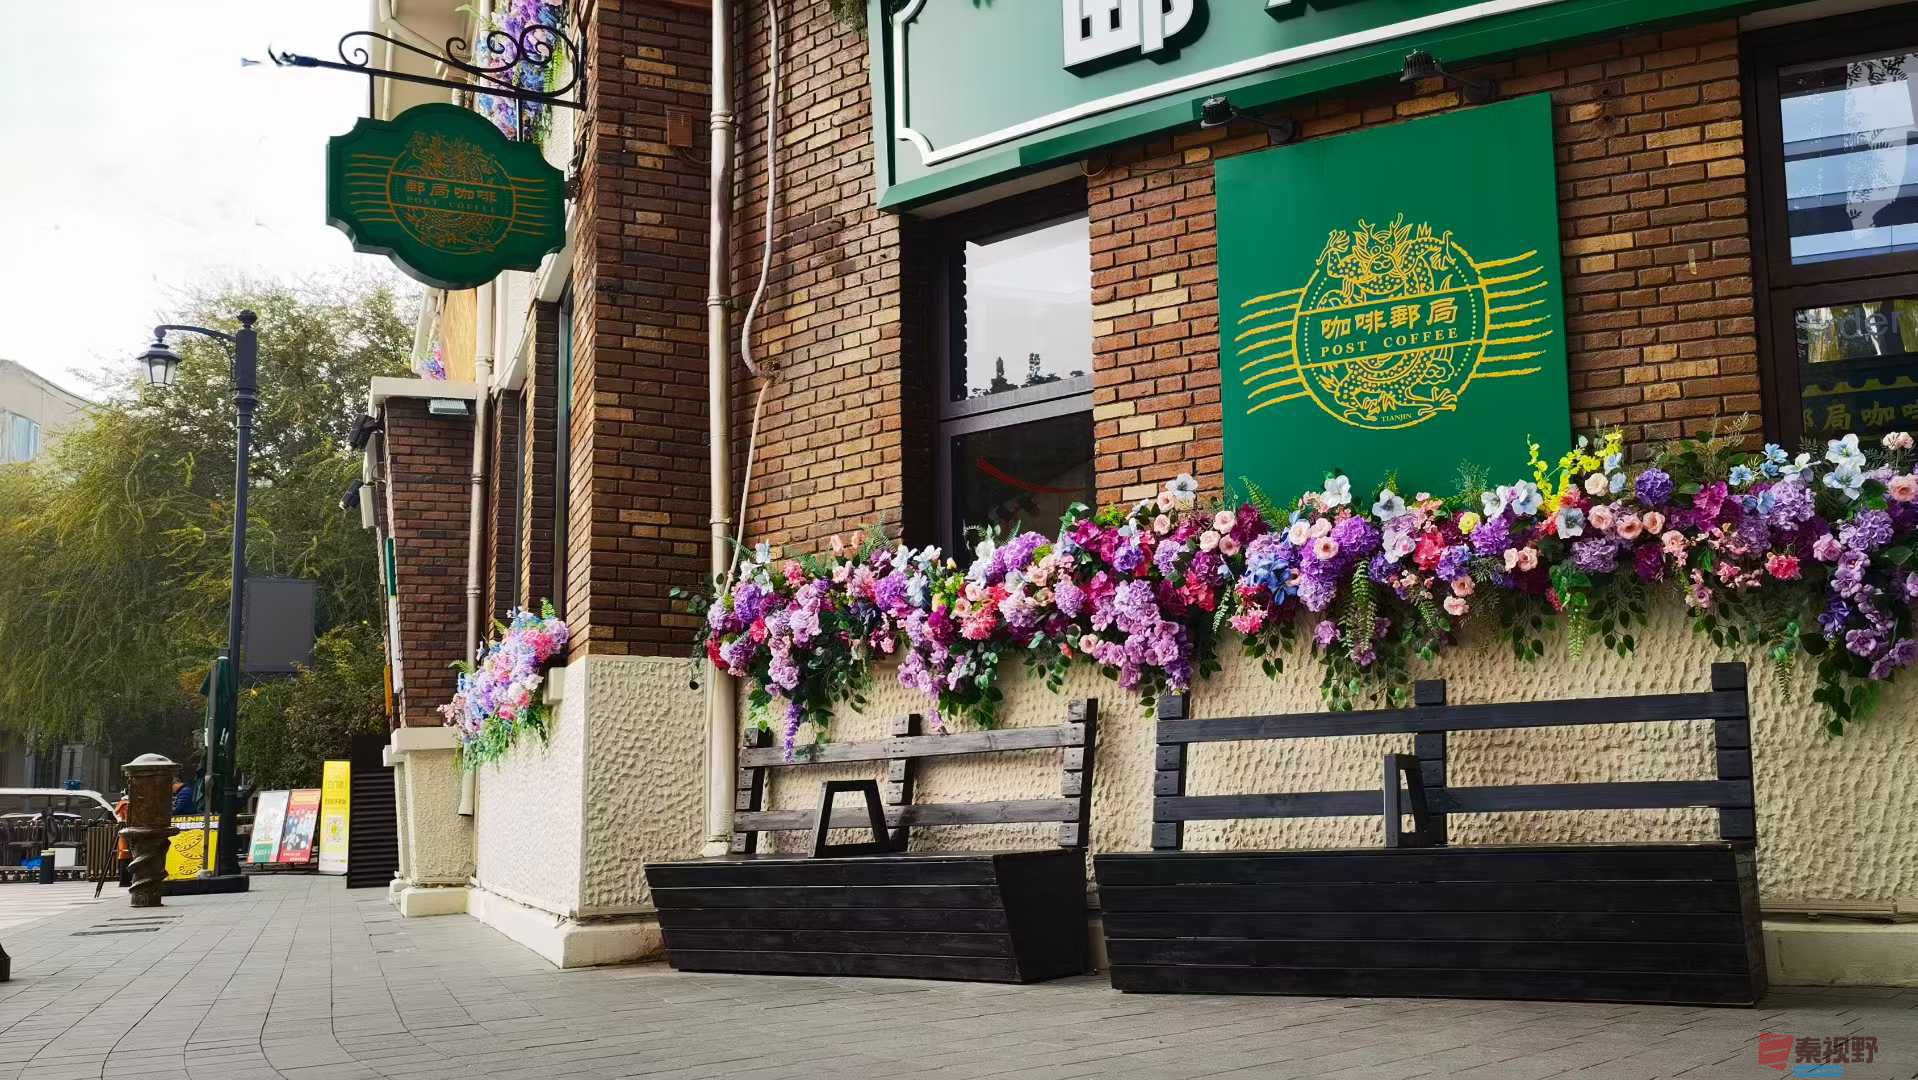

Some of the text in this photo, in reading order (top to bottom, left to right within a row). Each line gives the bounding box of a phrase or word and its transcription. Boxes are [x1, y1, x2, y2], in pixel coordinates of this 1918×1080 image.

[1321, 297, 1458, 340] 咖啡郵局
[1321, 327, 1458, 358] POST COFFEE
[1381, 412, 1413, 423] TIANJIN
